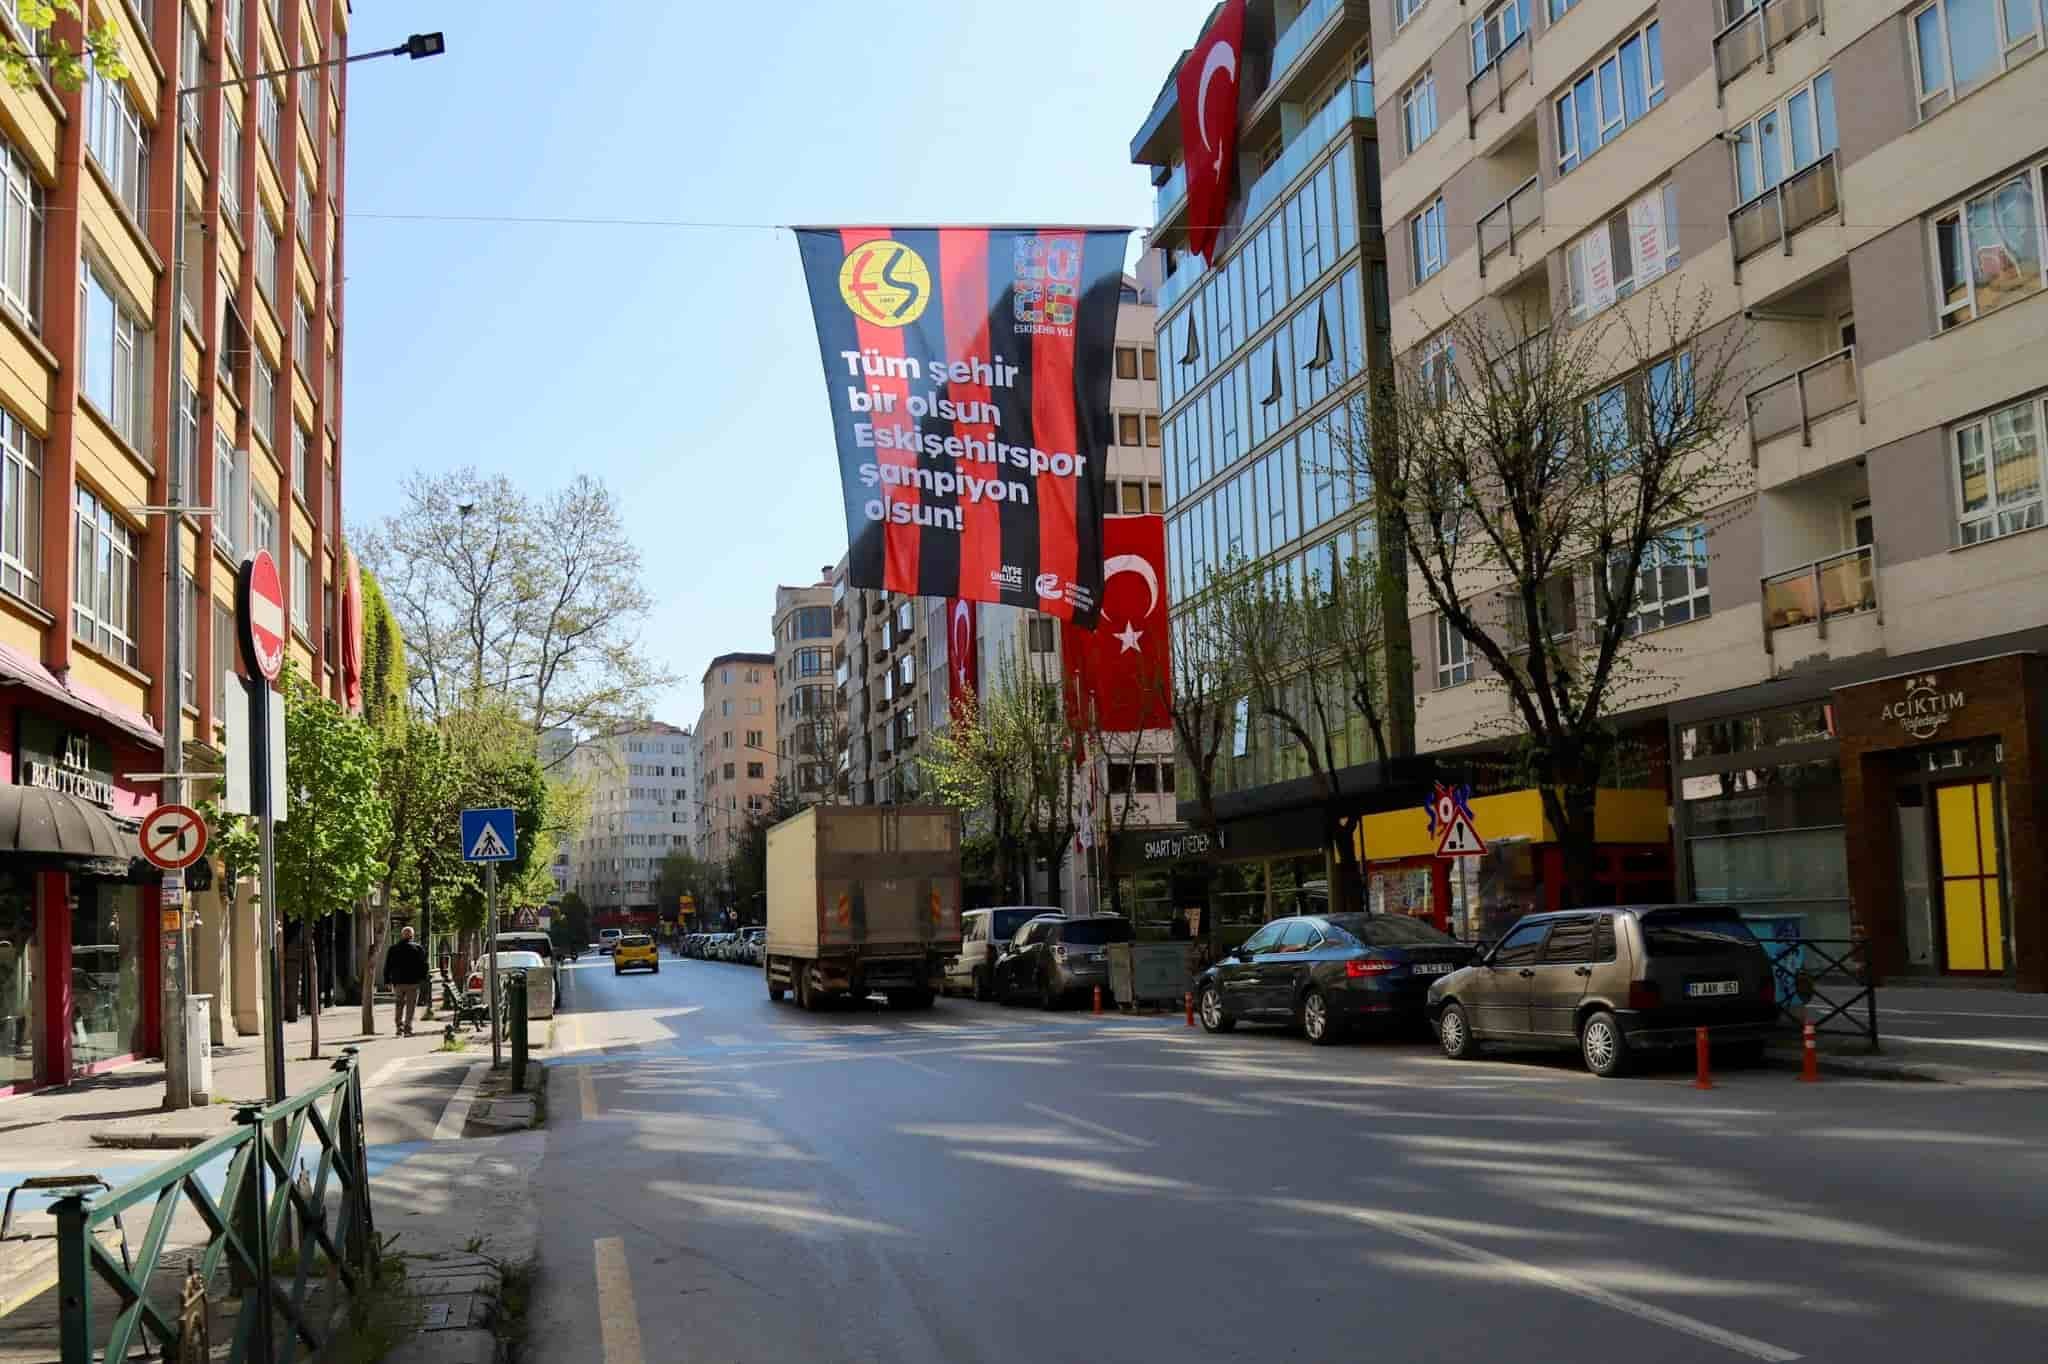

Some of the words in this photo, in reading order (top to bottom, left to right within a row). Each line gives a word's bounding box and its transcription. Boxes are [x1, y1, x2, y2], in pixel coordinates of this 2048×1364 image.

[841, 349, 920, 379] Tüm
[929, 355, 1018, 387] şehir
[848, 384, 897, 413] bir
[907, 391, 1000, 426] olsun
[854, 423, 1086, 477] Eskişehirspor
[859, 463, 1029, 504] şampiyon
[865, 495, 964, 530] olsun!
[31, 761, 77, 797] BEAUTY
[75, 774, 113, 807] CENTRE
[1145, 839, 1170, 859] SMART
[1171, 839, 1182, 860] by
